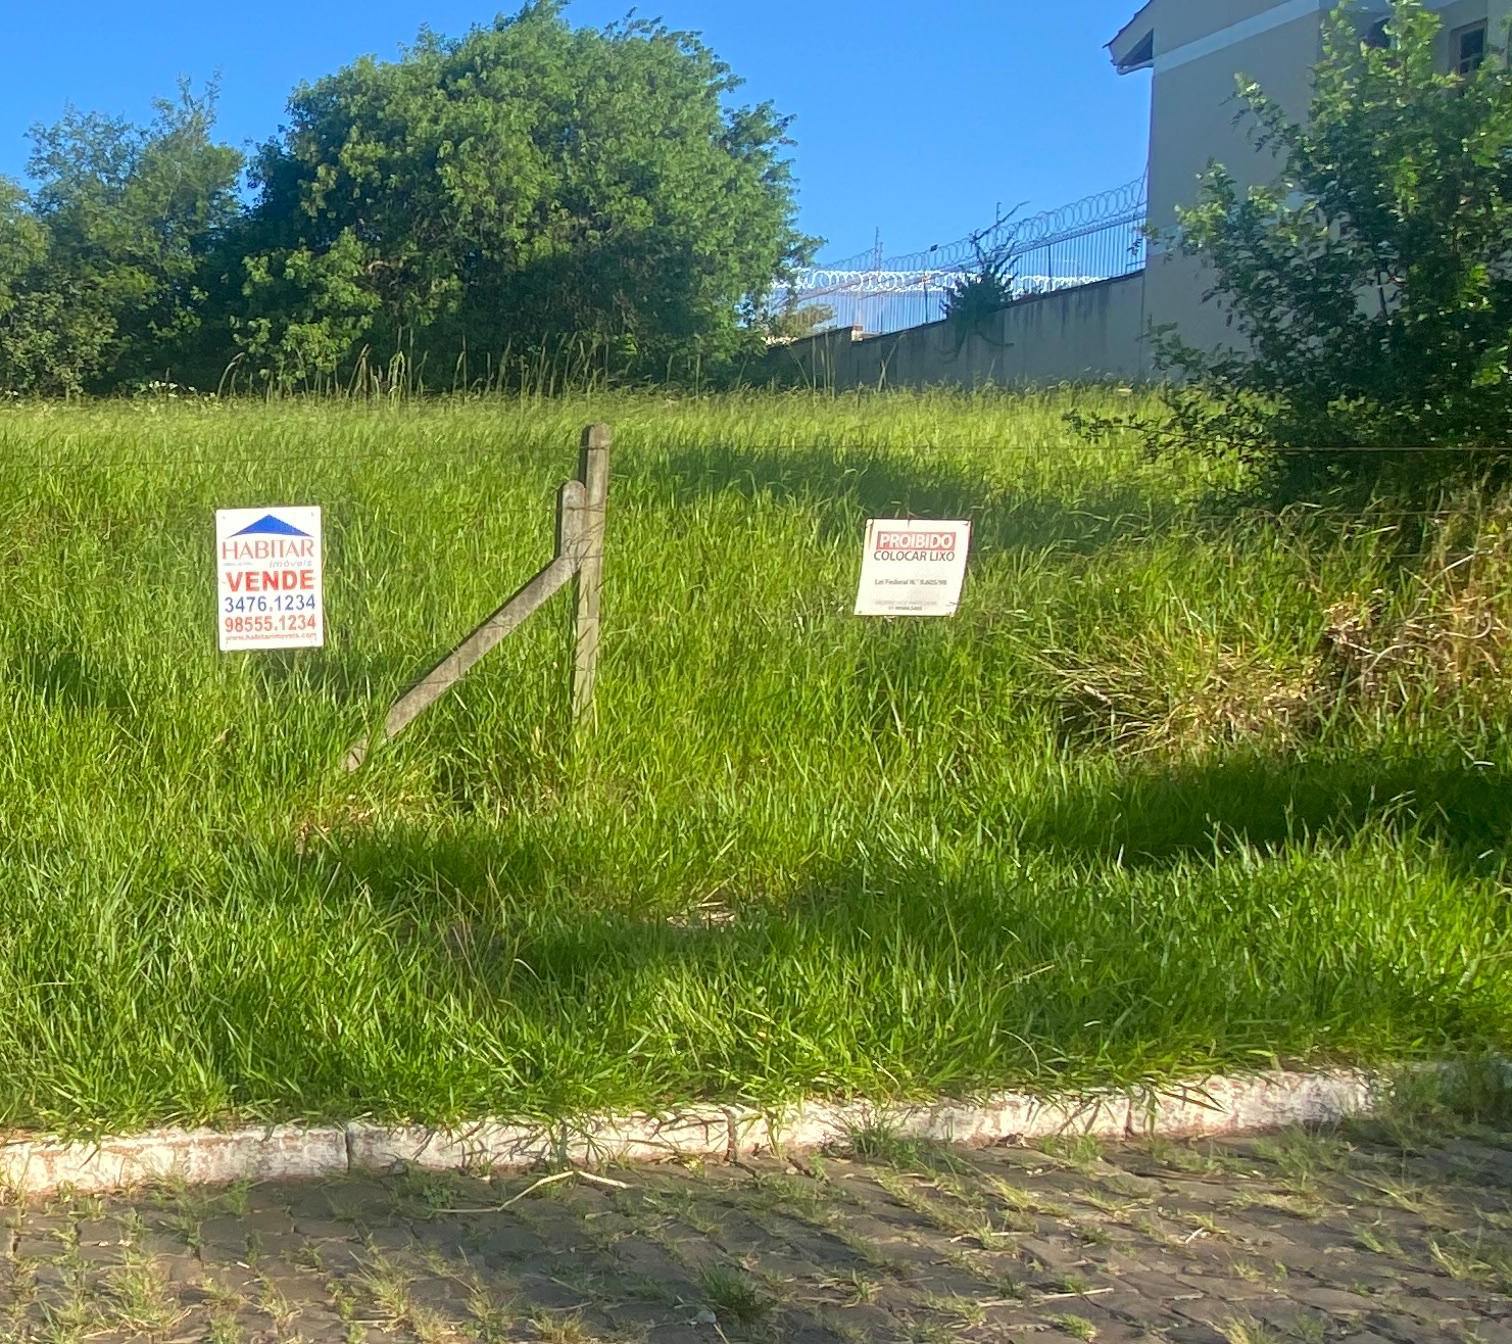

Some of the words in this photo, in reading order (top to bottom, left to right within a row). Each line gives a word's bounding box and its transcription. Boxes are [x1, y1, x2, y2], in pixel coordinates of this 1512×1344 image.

[222, 539, 314, 560] HABITAR
[879, 533, 953, 549] PROIBIDO
[874, 551, 927, 561] COLOCAR
[929, 551, 955, 562] LIXO
[226, 569, 315, 592] VENDE
[224, 594, 316, 613] 3476.1234
[224, 613, 316, 633] 98555.1234
